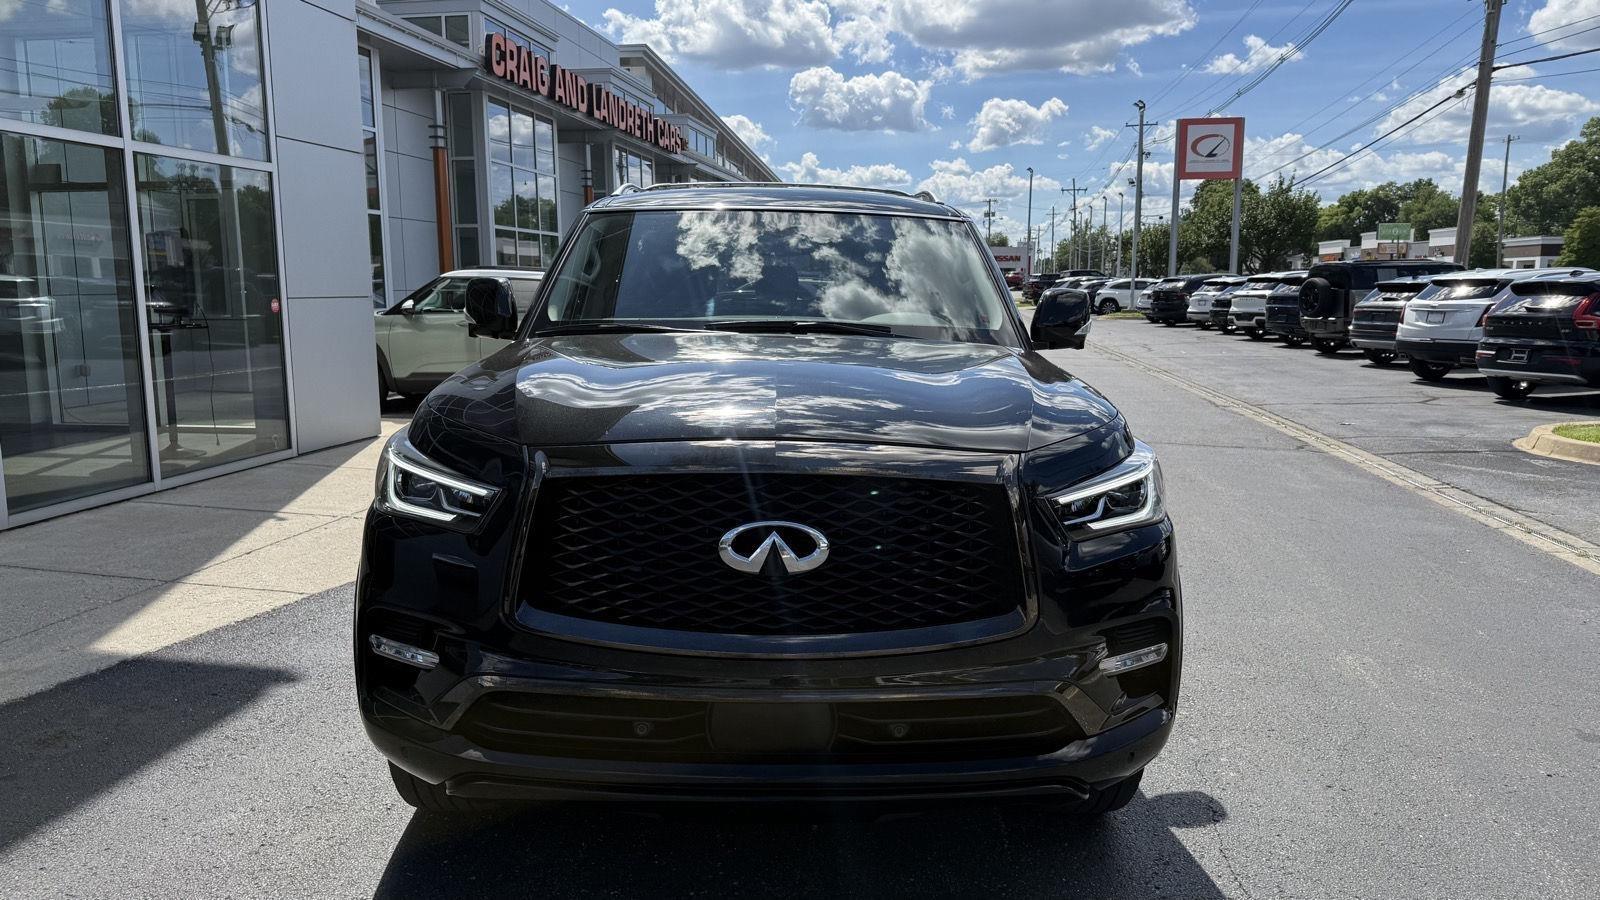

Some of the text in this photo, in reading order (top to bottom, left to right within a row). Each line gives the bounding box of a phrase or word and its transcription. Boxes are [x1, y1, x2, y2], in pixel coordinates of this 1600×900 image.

[488, 31, 682, 155] CRAIG AND LANDRETH CARS
